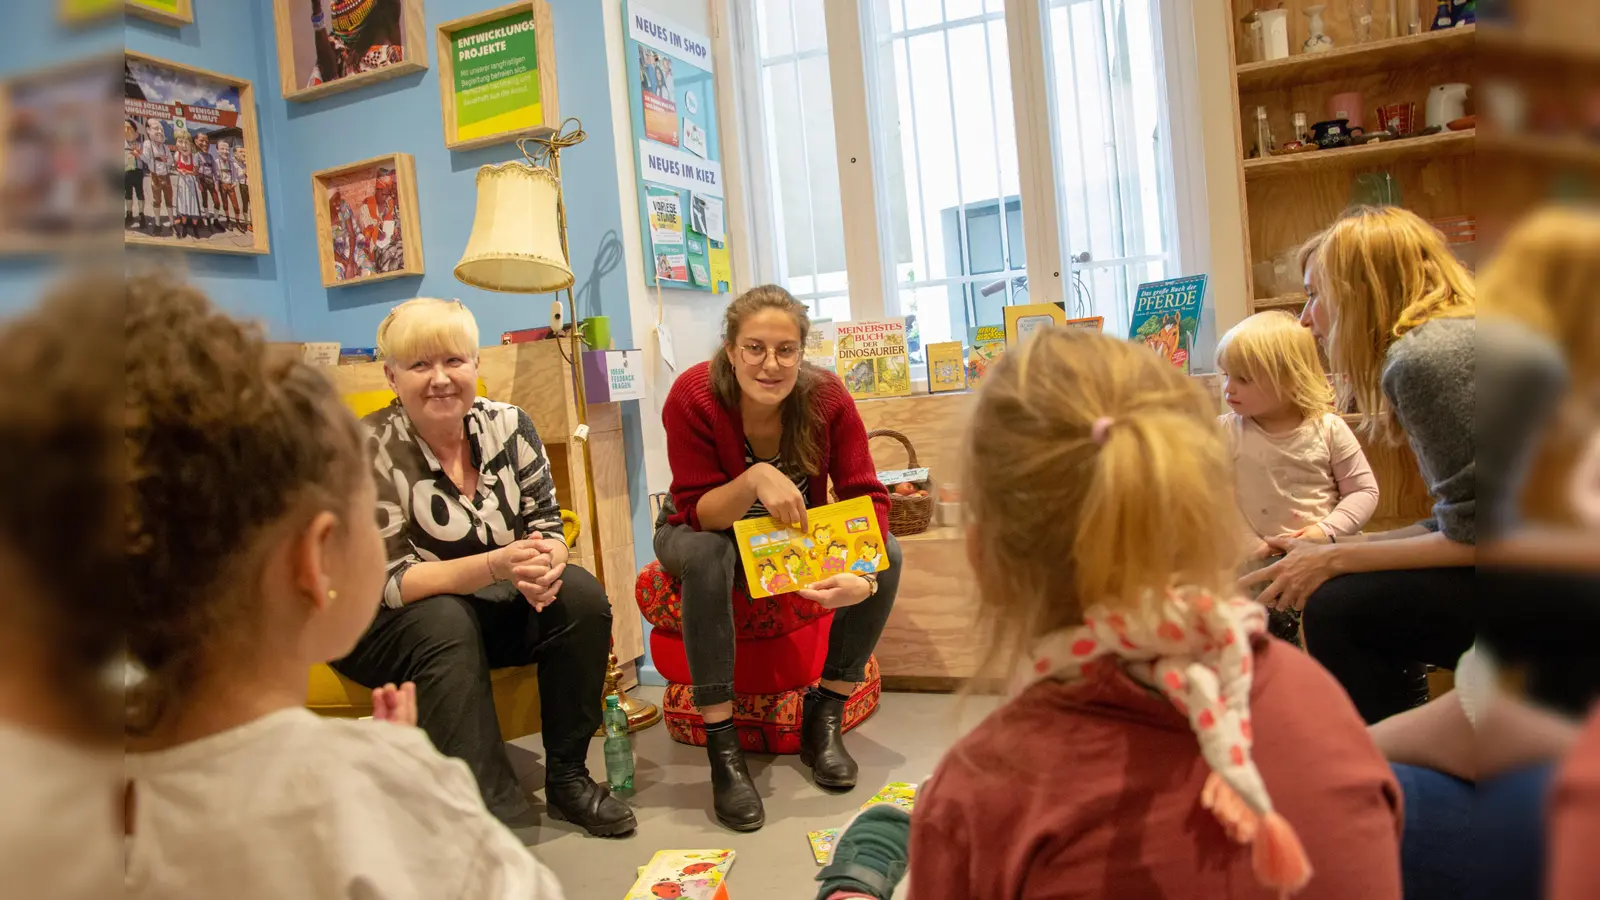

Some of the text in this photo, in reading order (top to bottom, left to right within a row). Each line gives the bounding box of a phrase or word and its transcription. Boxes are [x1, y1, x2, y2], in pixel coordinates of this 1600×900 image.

[458, 20, 535, 49] ENTWICKLUNGS
[636, 15, 707, 58] NEUES IM SHOP
[458, 41, 507, 62] PROJEKTE
[144, 101, 169, 112] SOZIALE
[189, 106, 220, 117] WENIGER
[193, 113, 218, 123] ARMUT
[649, 154, 716, 185] NEUES IM KIEZ
[1137, 290, 1197, 312] PFERDE
[838, 326, 864, 335] MEIN
[865, 323, 902, 332] ERSTES
[855, 333, 884, 342] BUCH
[839, 346, 905, 359] DINOSAURIER
